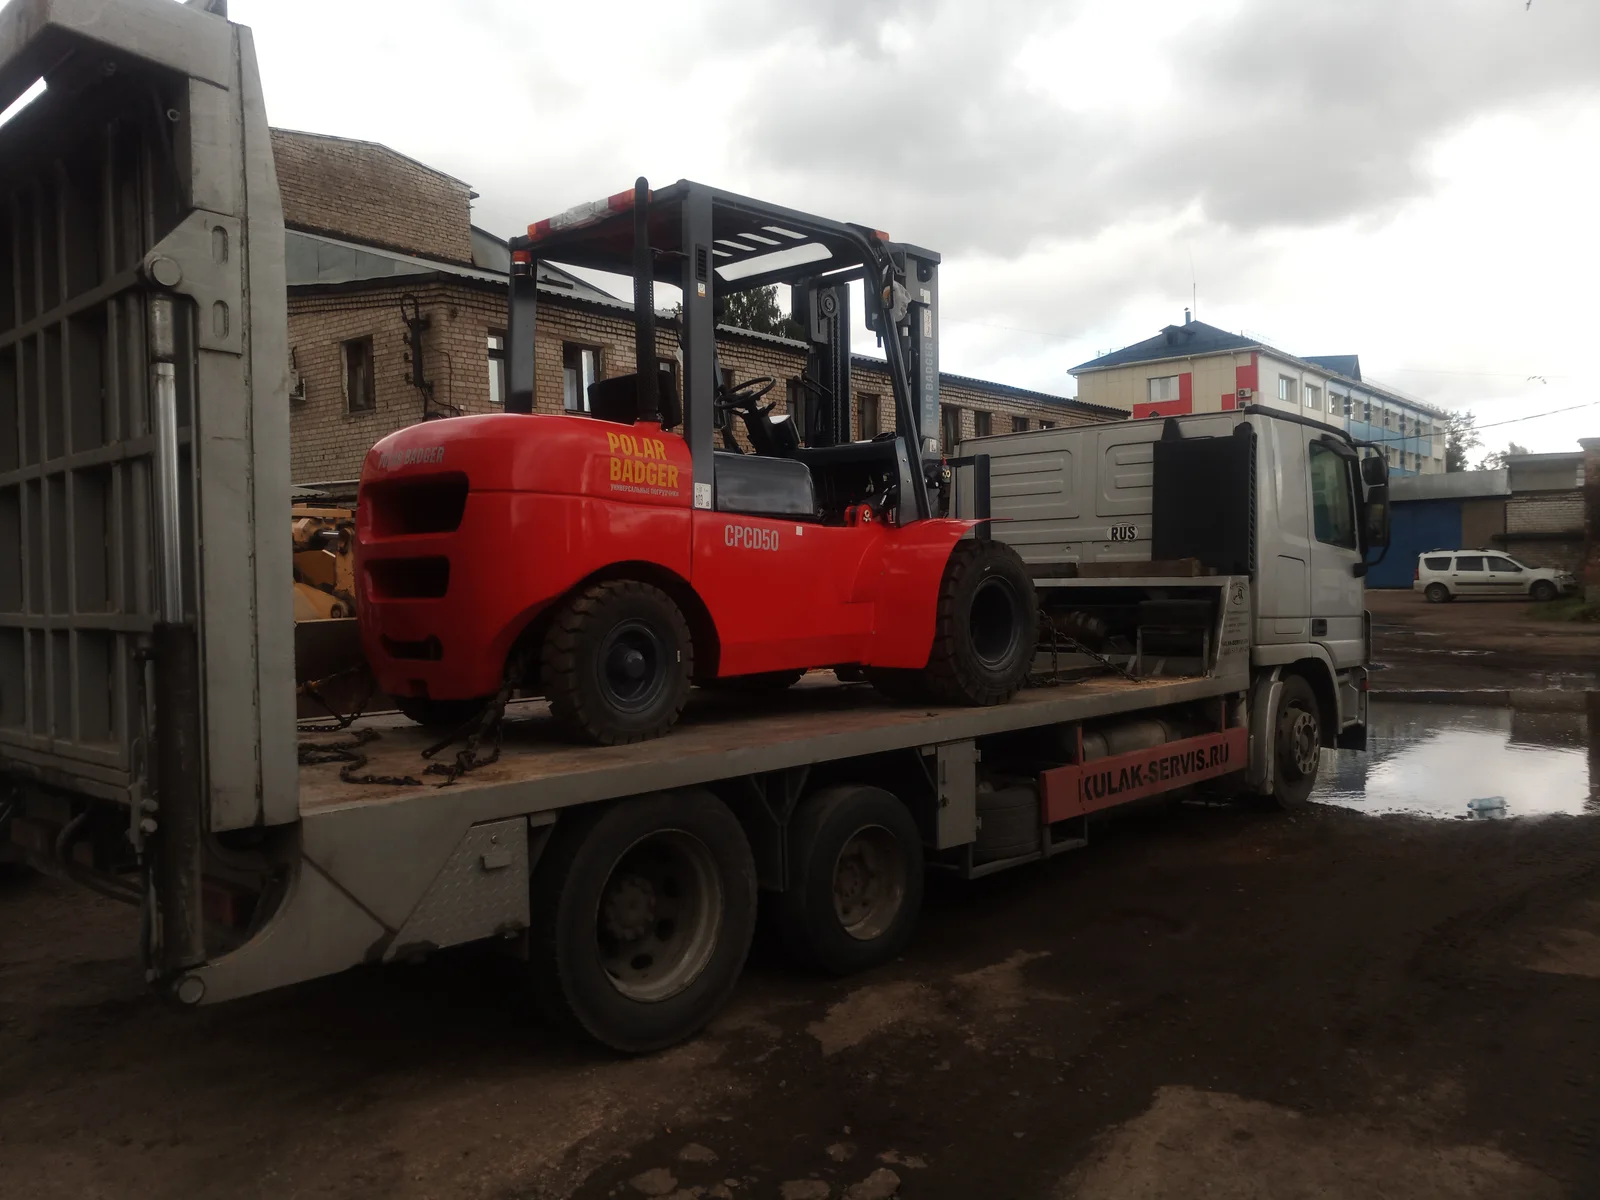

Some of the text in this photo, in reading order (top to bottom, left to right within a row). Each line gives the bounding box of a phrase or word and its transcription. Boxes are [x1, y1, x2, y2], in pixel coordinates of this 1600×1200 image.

[925, 342, 934, 391] BADGER
[404, 446, 444, 465] BADGER
[606, 431, 668, 461] POLAR
[610, 456, 679, 489] BADGER
[724, 524, 779, 552] CPCD50
[1111, 526, 1136, 541] RUS
[1078, 743, 1229, 803] KULAK-SERVIS.RU
